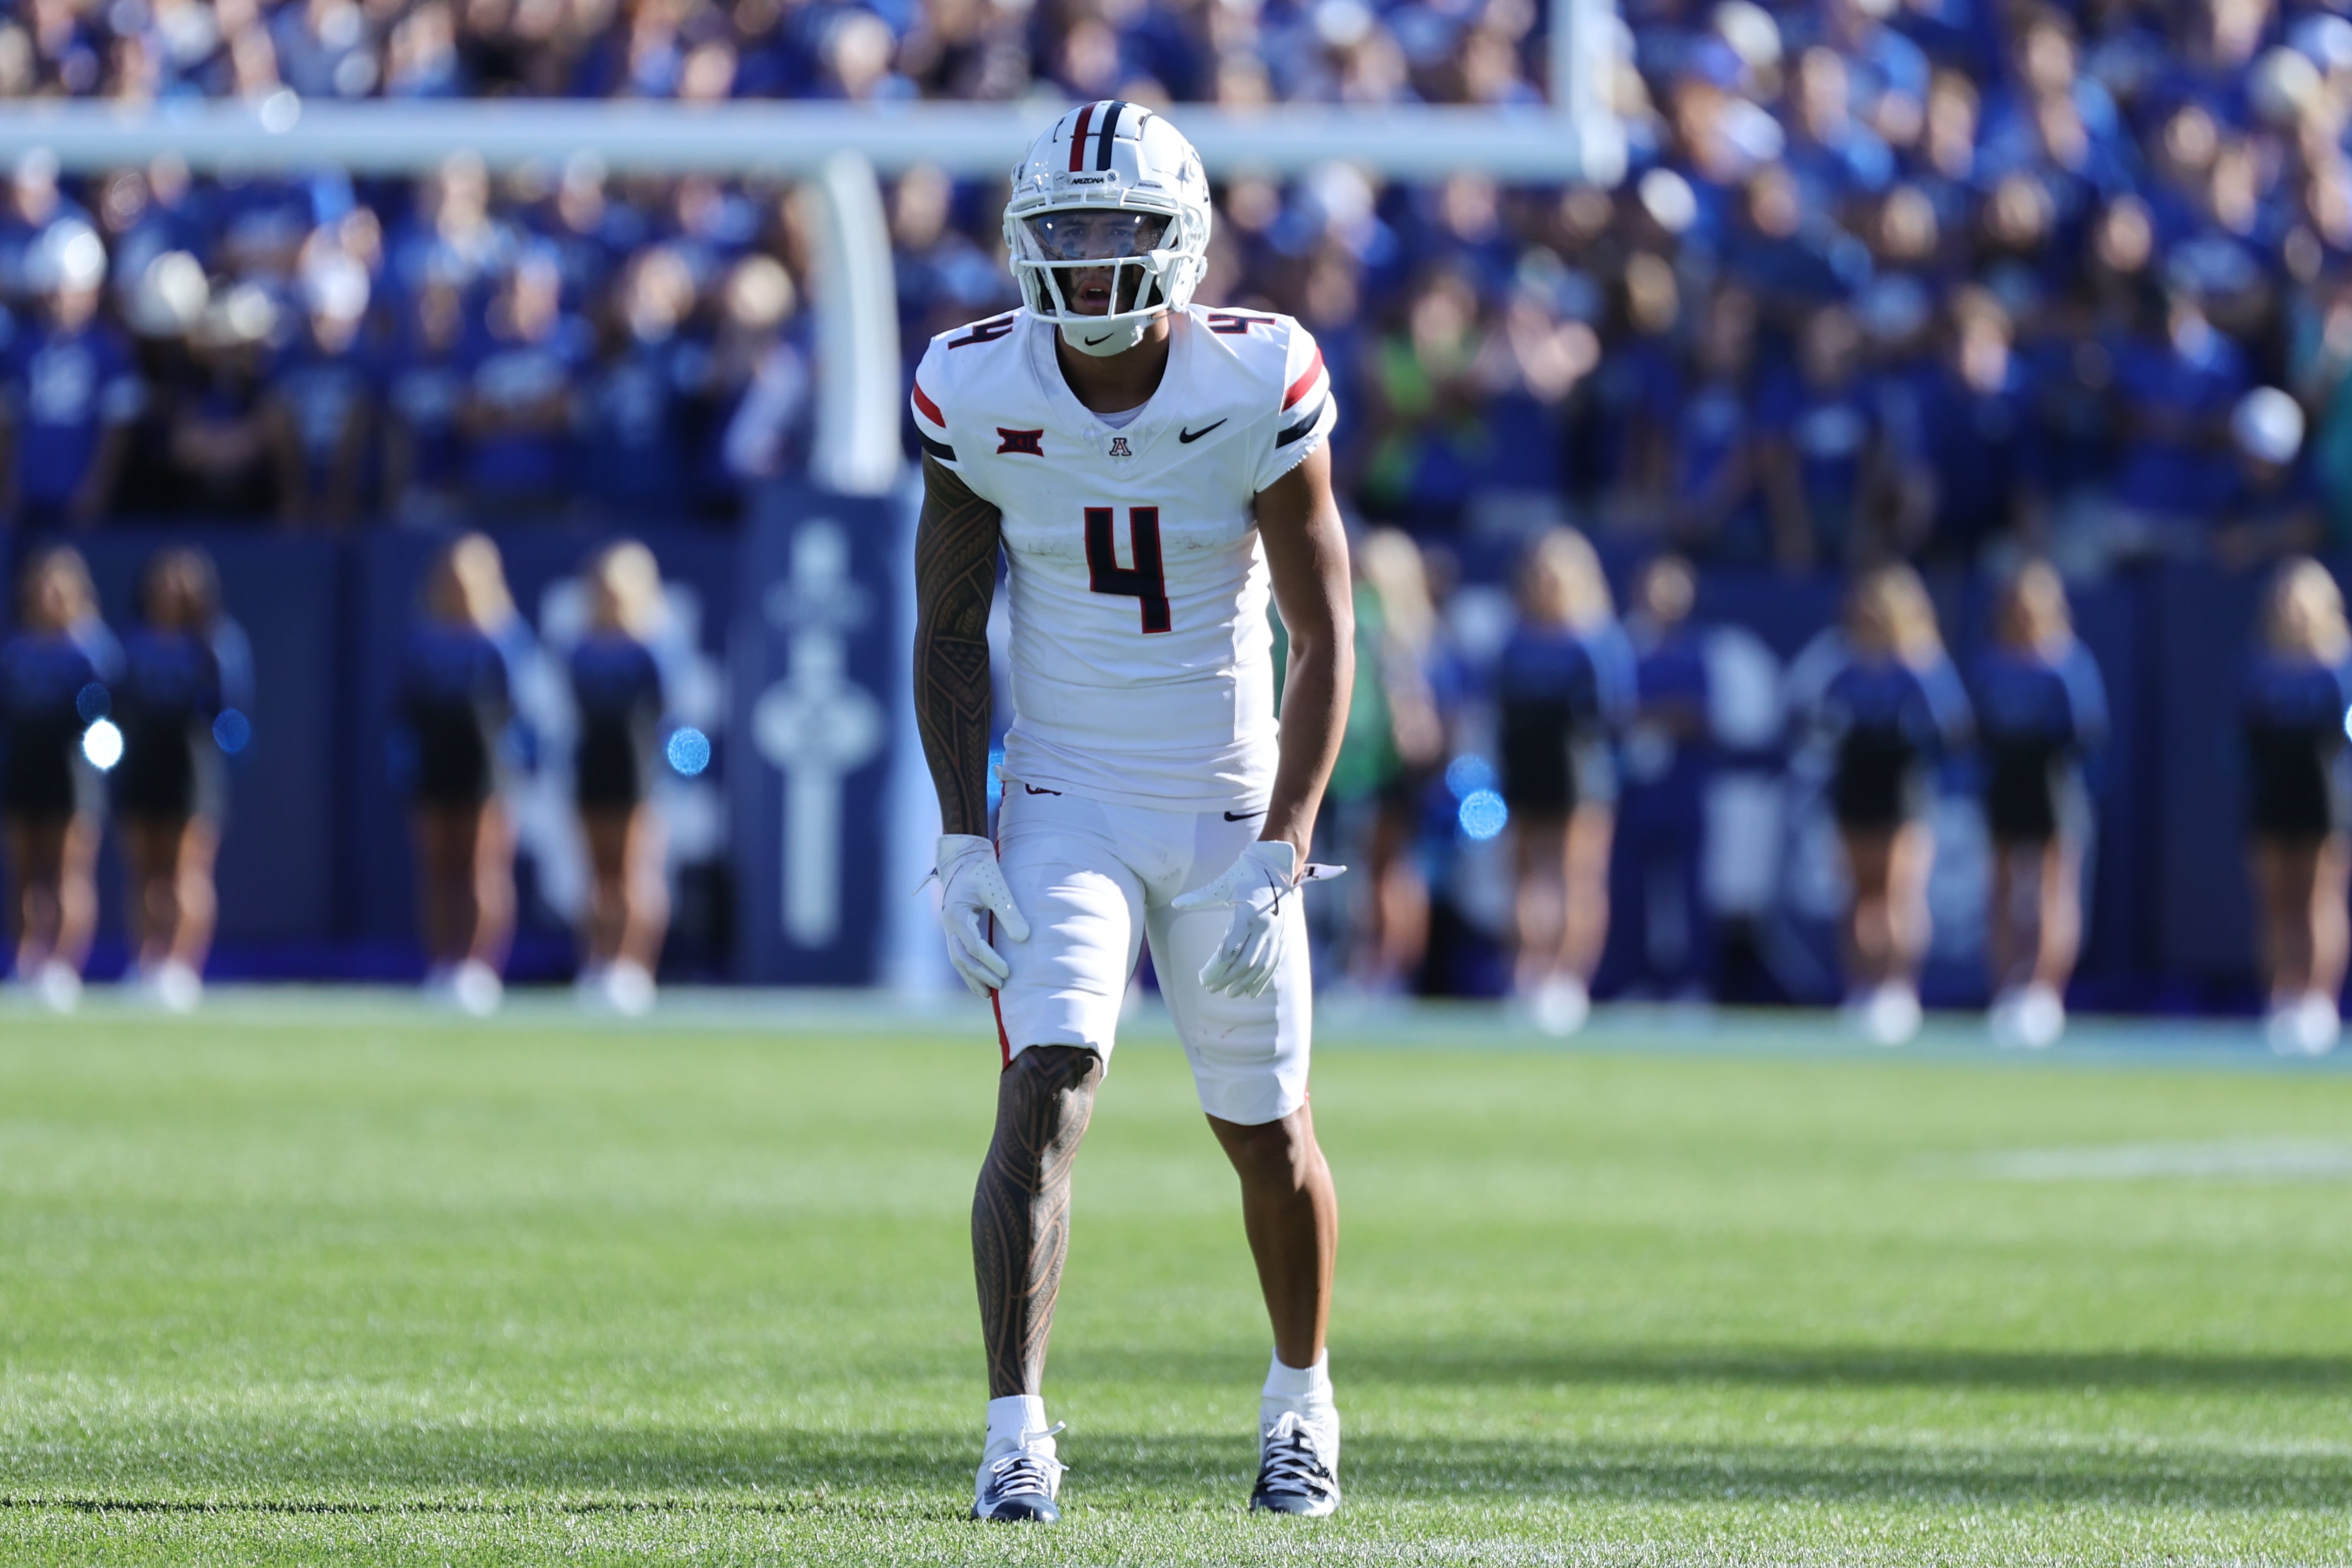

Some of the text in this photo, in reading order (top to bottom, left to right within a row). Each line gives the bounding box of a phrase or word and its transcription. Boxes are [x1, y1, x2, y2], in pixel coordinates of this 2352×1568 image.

[948, 315, 1013, 350] 4
[1208, 313, 1276, 334] 4
[1109, 437, 1131, 456] A
[1084, 506, 1171, 634] 4
